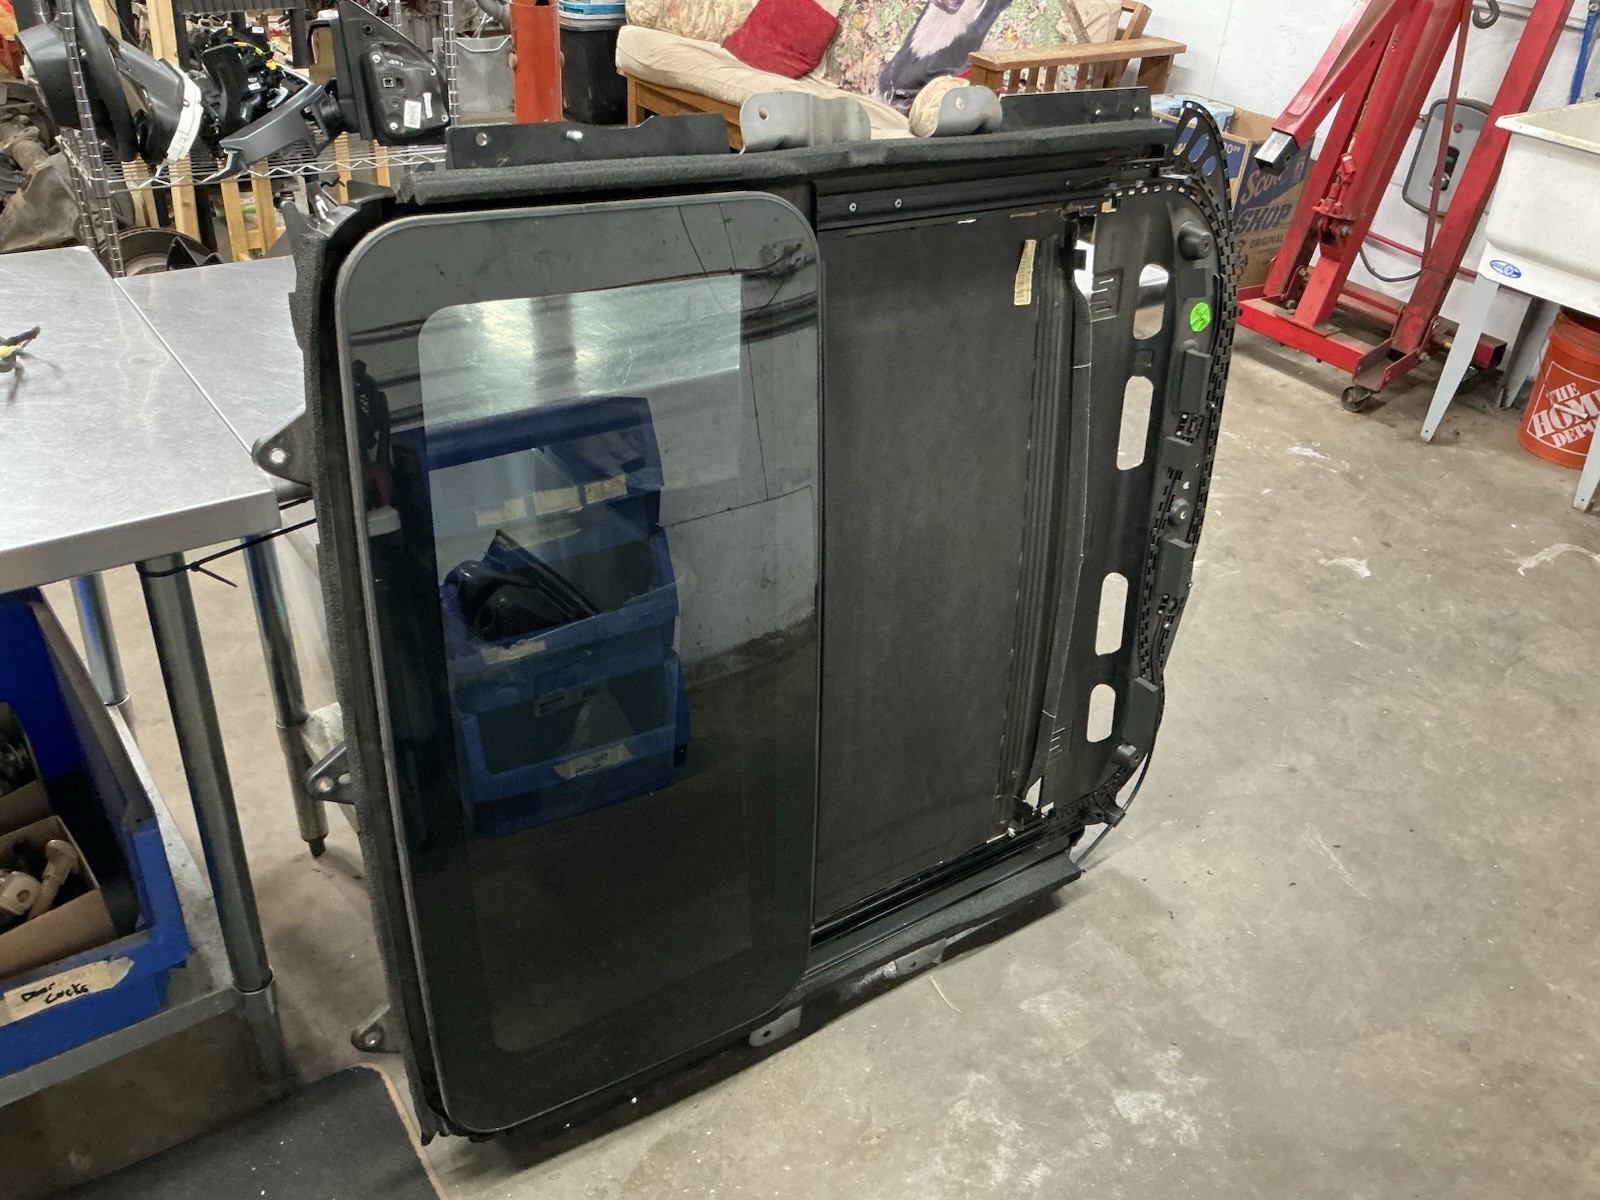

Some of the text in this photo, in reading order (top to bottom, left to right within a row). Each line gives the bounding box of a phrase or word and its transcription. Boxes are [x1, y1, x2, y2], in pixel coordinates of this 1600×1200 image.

[1233, 202, 1293, 235] SHOP
[1545, 382, 1581, 405] THE
[1551, 419, 1597, 447] DEPO
